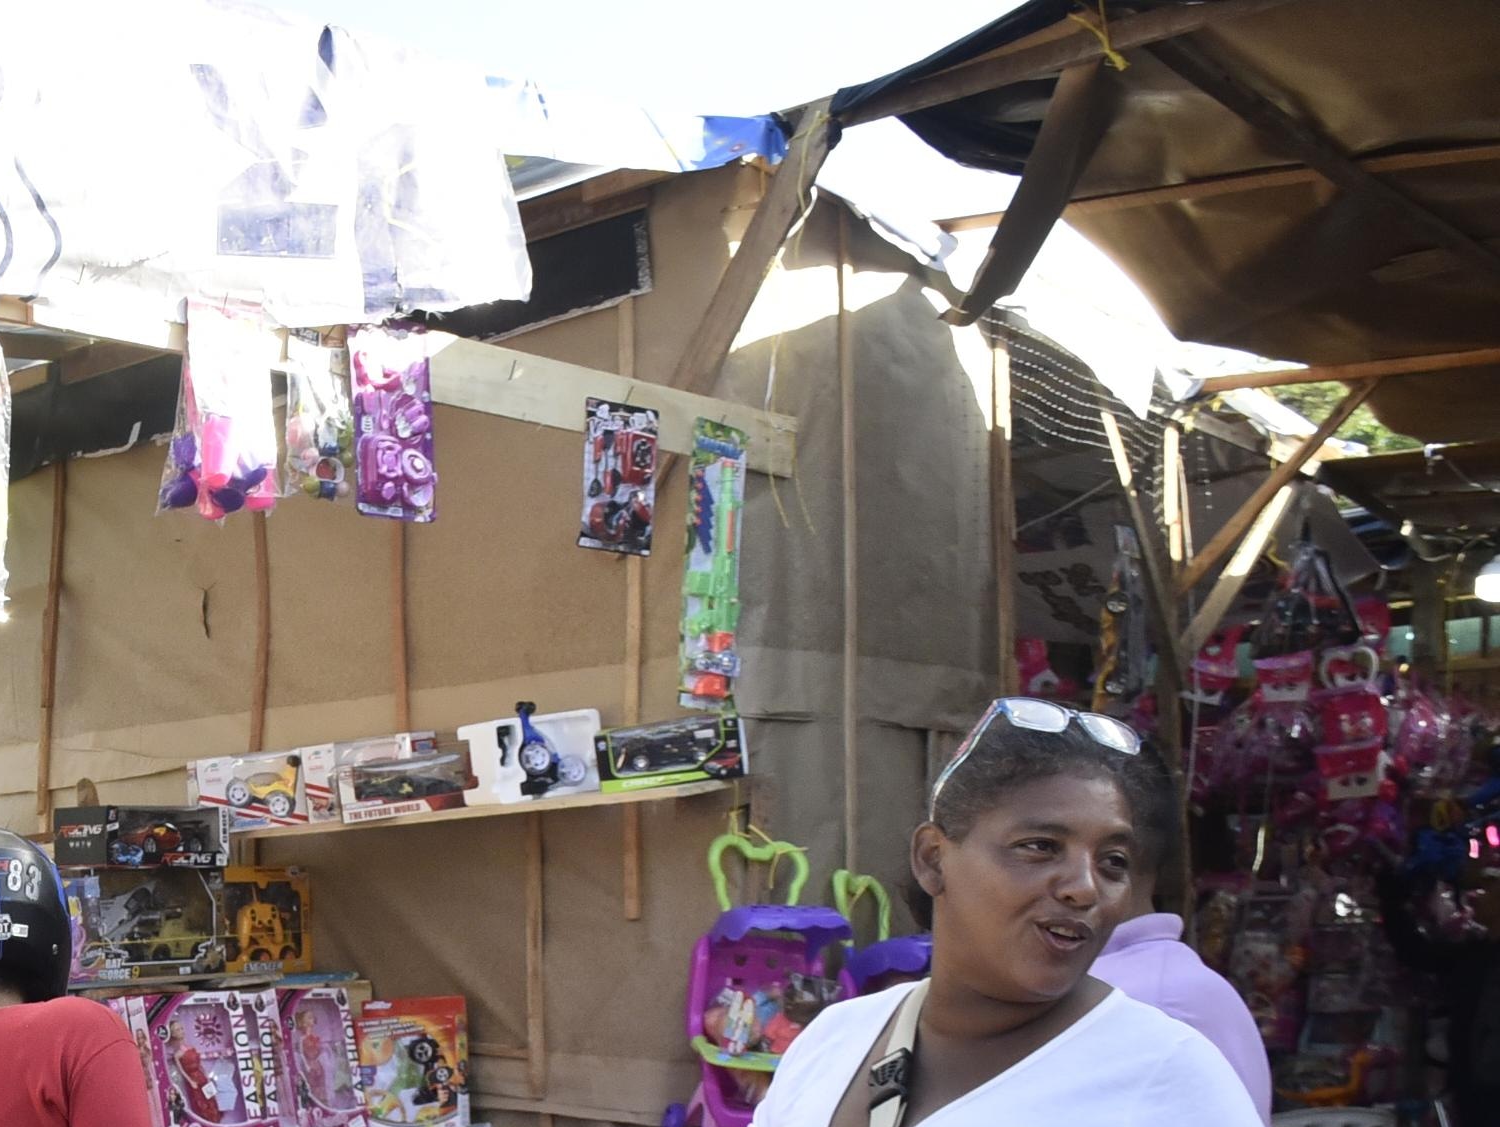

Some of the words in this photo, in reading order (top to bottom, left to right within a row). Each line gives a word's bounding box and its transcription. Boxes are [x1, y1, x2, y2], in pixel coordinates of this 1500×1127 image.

[349, 810, 364, 821] THE
[365, 806, 393, 819] FUTURE
[393, 802, 422, 816] WORLD
[231, 1014, 262, 1120] FASHION
[258, 1015, 280, 1118] FASHION
[340, 1009, 366, 1108] FASHION
